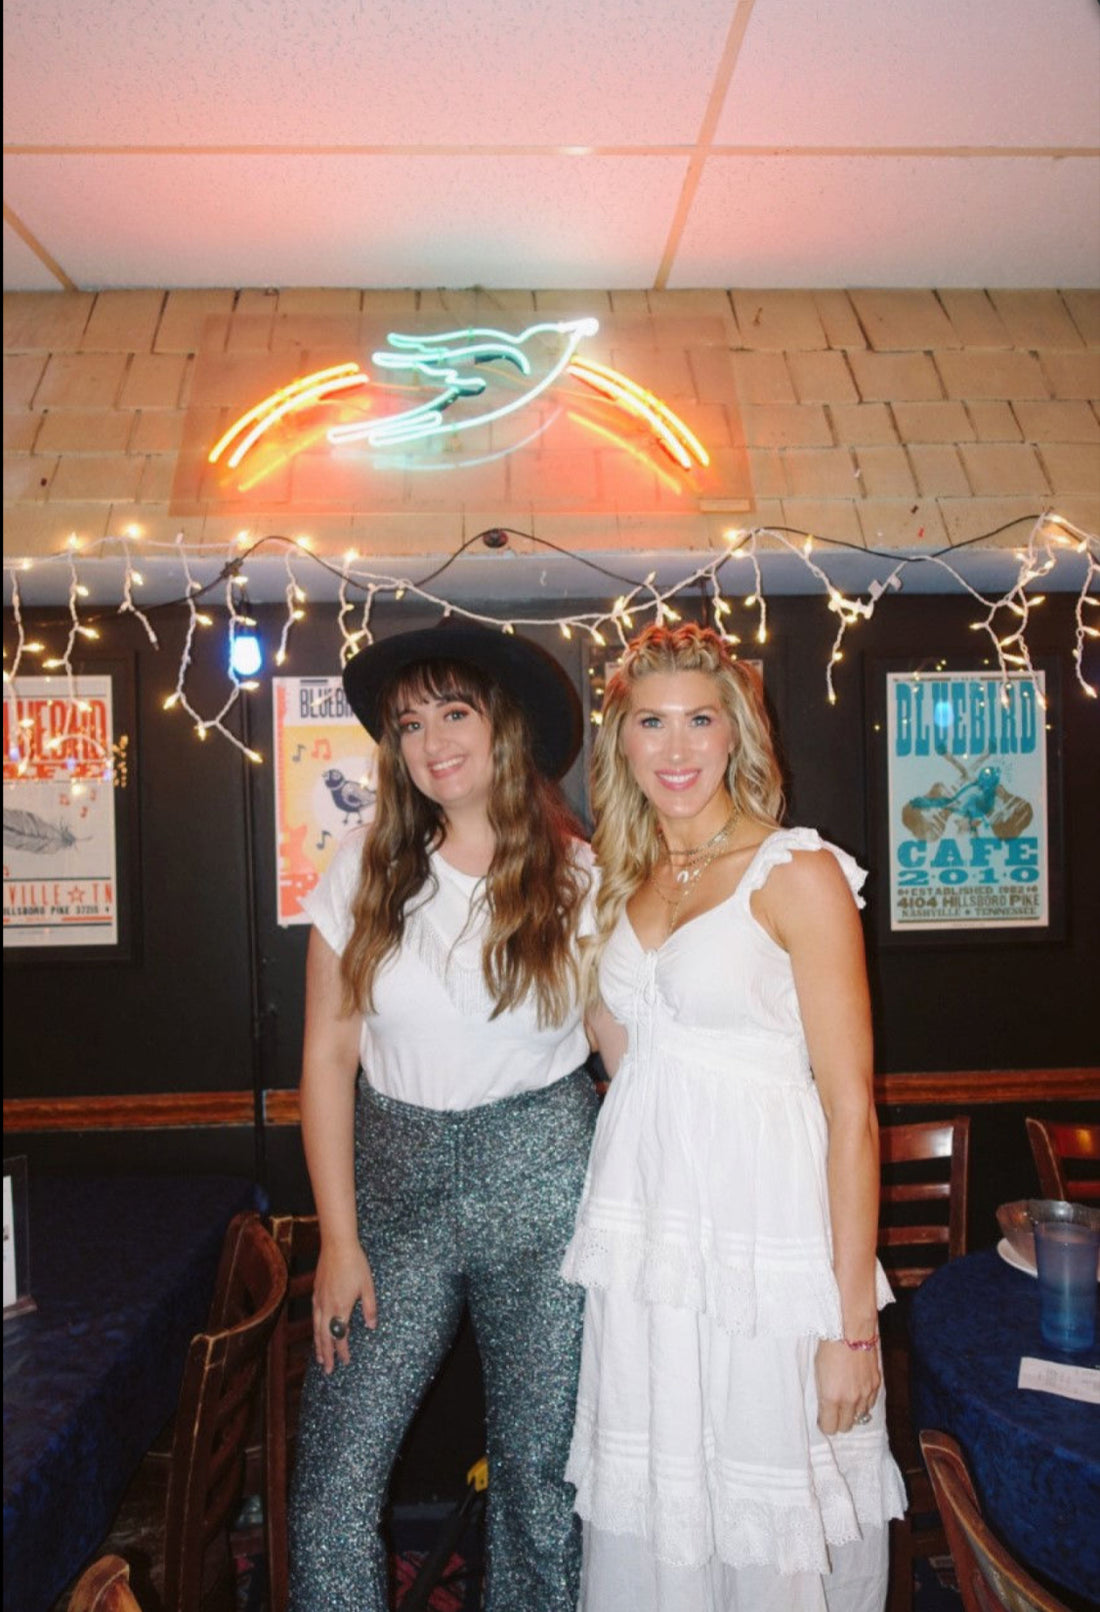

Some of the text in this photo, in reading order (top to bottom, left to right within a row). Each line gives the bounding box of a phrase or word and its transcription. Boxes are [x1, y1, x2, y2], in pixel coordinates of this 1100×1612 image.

[299, 687, 353, 718] BLUEB
[895, 682, 1037, 756] BLUEBIRD
[897, 837, 1038, 868] CAFE
[92, 882, 113, 904] TN
[897, 894, 1040, 908] 4104 HILLSBORO PIKE
[902, 906, 1037, 917] NASHVILLE TENNESSEE
